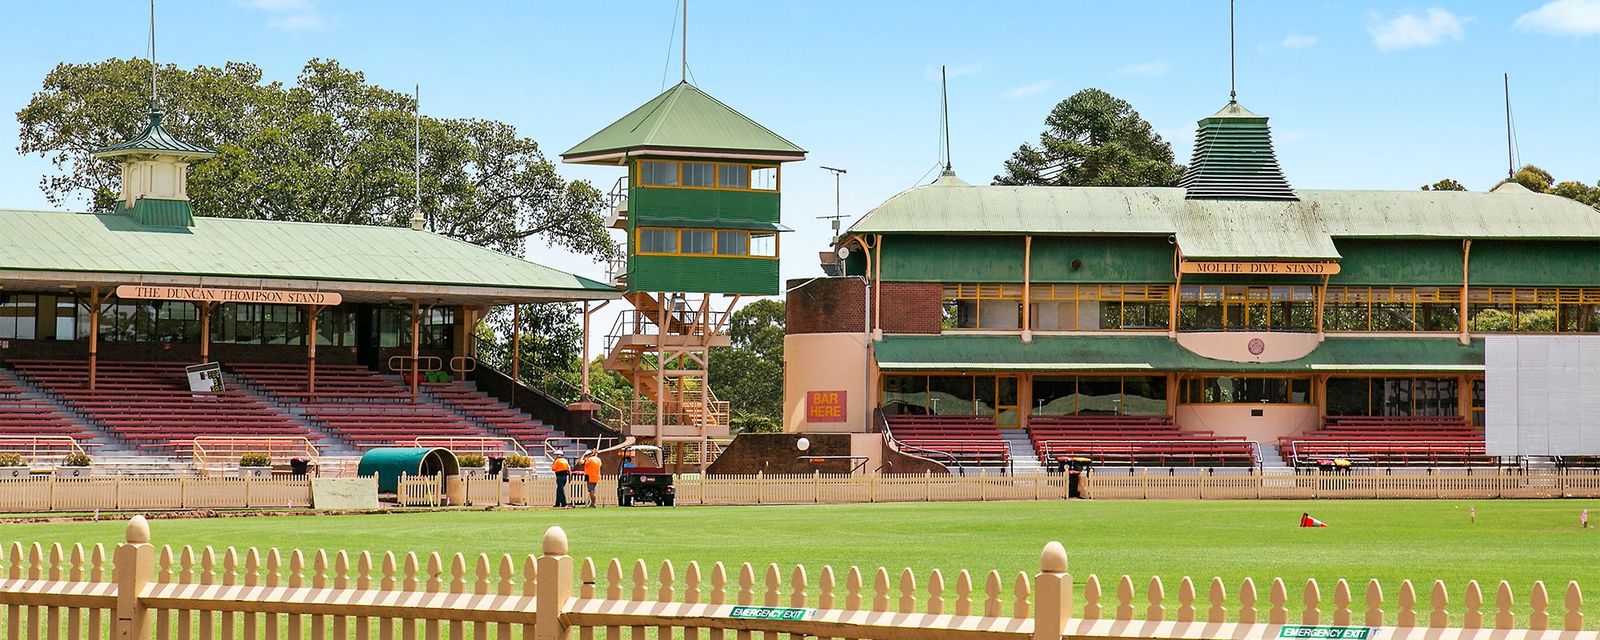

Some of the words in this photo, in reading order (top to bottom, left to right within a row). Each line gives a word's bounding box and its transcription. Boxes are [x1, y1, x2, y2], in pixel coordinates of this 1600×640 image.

[1197, 263, 1243, 273] MOLLIE
[1250, 263, 1279, 273] DIVE
[1285, 263, 1324, 273] STAND
[135, 286, 160, 298] THE
[167, 288, 215, 300] DUNCAN
[221, 290, 283, 302] THOMPSON
[287, 293, 325, 304] STAND
[813, 392, 839, 405] BAR
[810, 405, 841, 417] HERE
[733, 608, 783, 618] EMERGENCY
[784, 610, 804, 619] EXIT
[1283, 627, 1343, 637] EMERGENCY
[1342, 629, 1366, 638] EXIT
